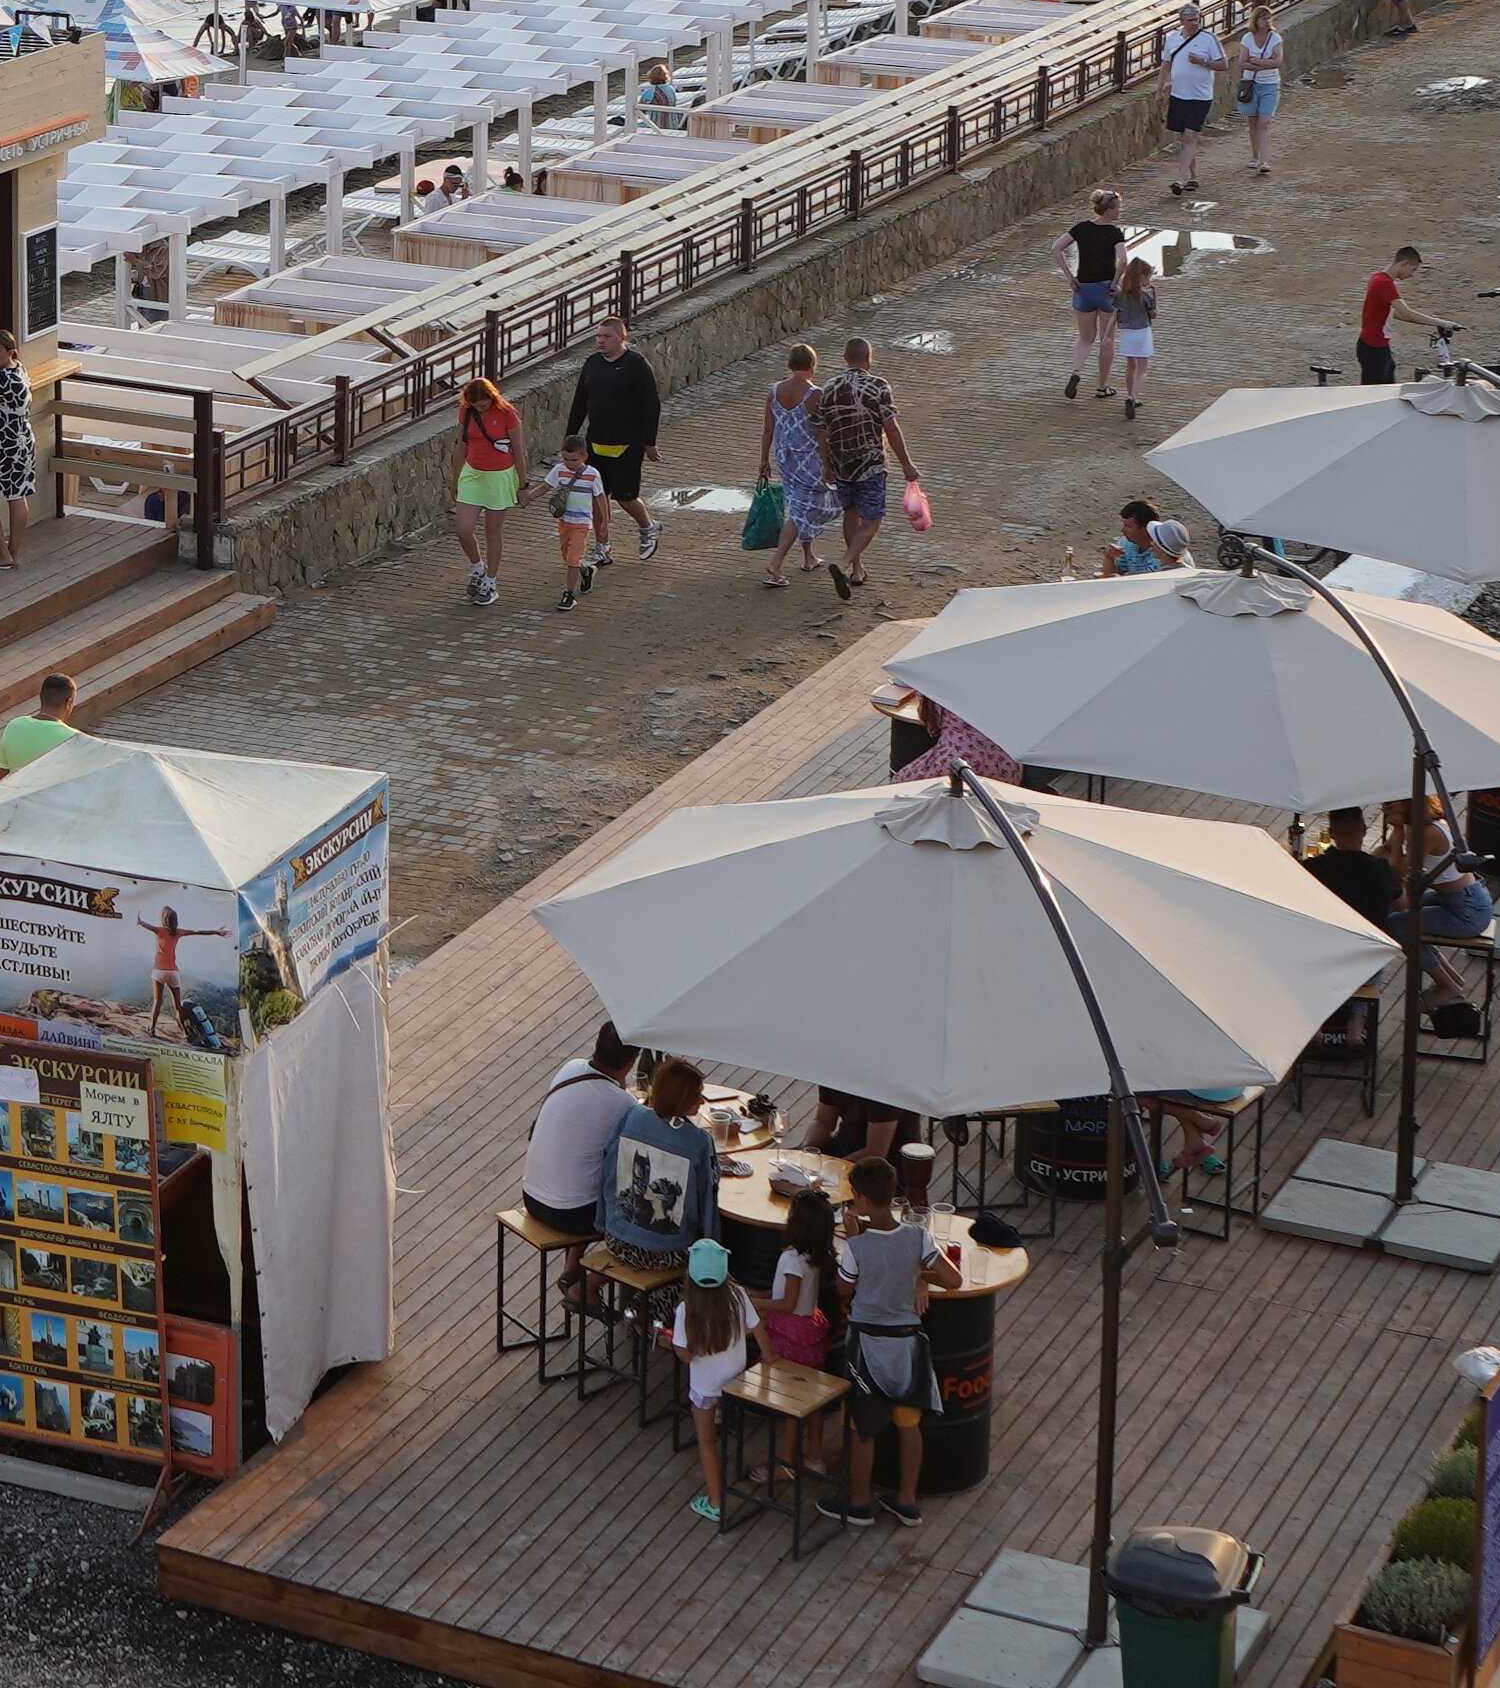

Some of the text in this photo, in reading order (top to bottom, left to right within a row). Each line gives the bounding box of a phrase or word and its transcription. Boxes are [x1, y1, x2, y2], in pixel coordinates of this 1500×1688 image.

[26, 119, 90, 152] УСТРИЧНЫХ
[305, 809, 373, 875] ЭКСКУРСИИ
[1, 937, 58, 959] БУДЬТЕ
[40, 1029, 99, 1051] ДАЙВИНГ
[160, 1047, 190, 1061] БЕЛАЯ
[191, 1052, 224, 1066] СКАЛА
[10, 1054, 140, 1091] ЭКСКУРСИИ
[85, 1087, 140, 1106] Морем в
[90, 1110, 136, 1129] ЯЛТУ
[1064, 1118, 1109, 1134] МОР
